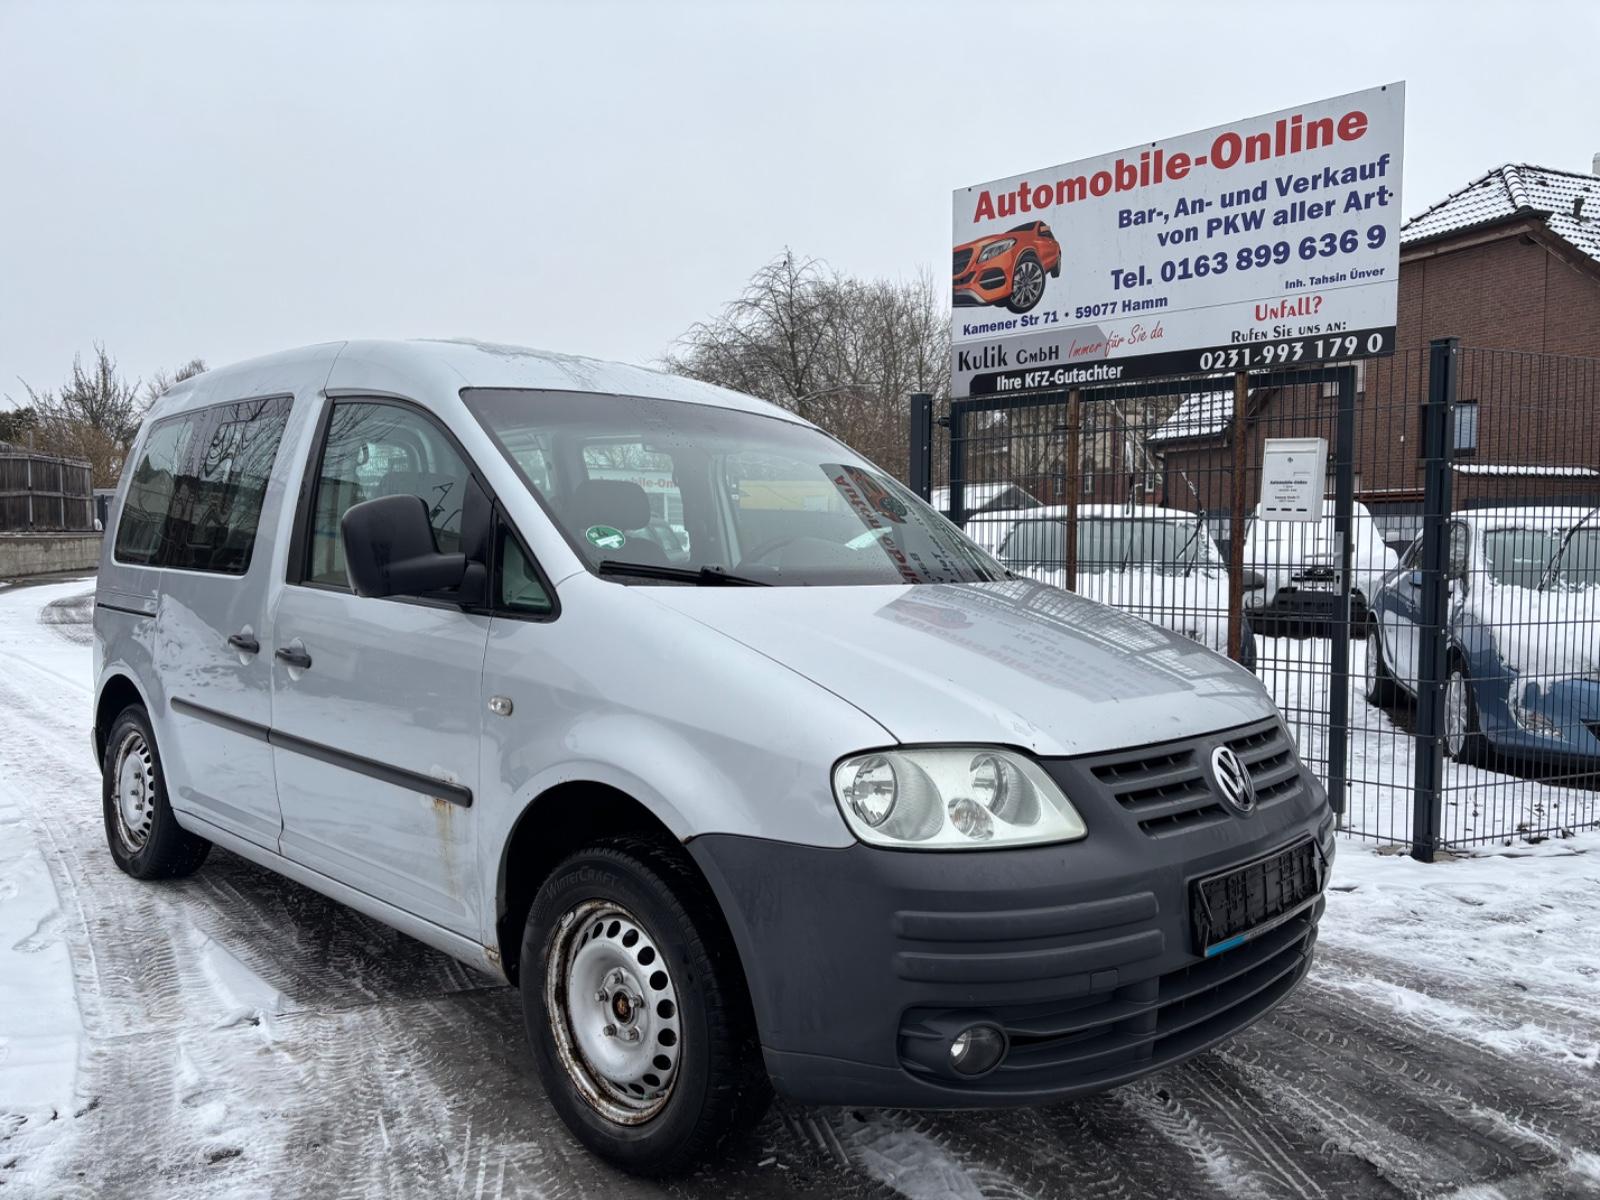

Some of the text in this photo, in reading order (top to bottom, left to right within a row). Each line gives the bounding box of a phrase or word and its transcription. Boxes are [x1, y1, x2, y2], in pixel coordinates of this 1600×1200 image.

[973, 110, 1369, 223] Automobile-Online
[1174, 197, 1213, 218] An-
[1220, 180, 1267, 208] und
[1275, 153, 1390, 197] Verkauf
[1157, 226, 1198, 246] von
[1206, 208, 1265, 238] PKW
[1272, 199, 1336, 226] aller
[1111, 224, 1387, 290] Tel. 0163 899 636 9
[1285, 267, 1385, 289] Inh. Tahsin Ünver
[963, 296, 1168, 336] Kamener Str 71 59077 Hamm
[958, 343, 1008, 372] Kulik
[1068, 320, 1164, 359] Immer für Sie da
[1314, 336, 1358, 359] 179
[1367, 332, 1384, 353] 0
[996, 364, 1123, 391] Ihre KFZ-Gutachter
